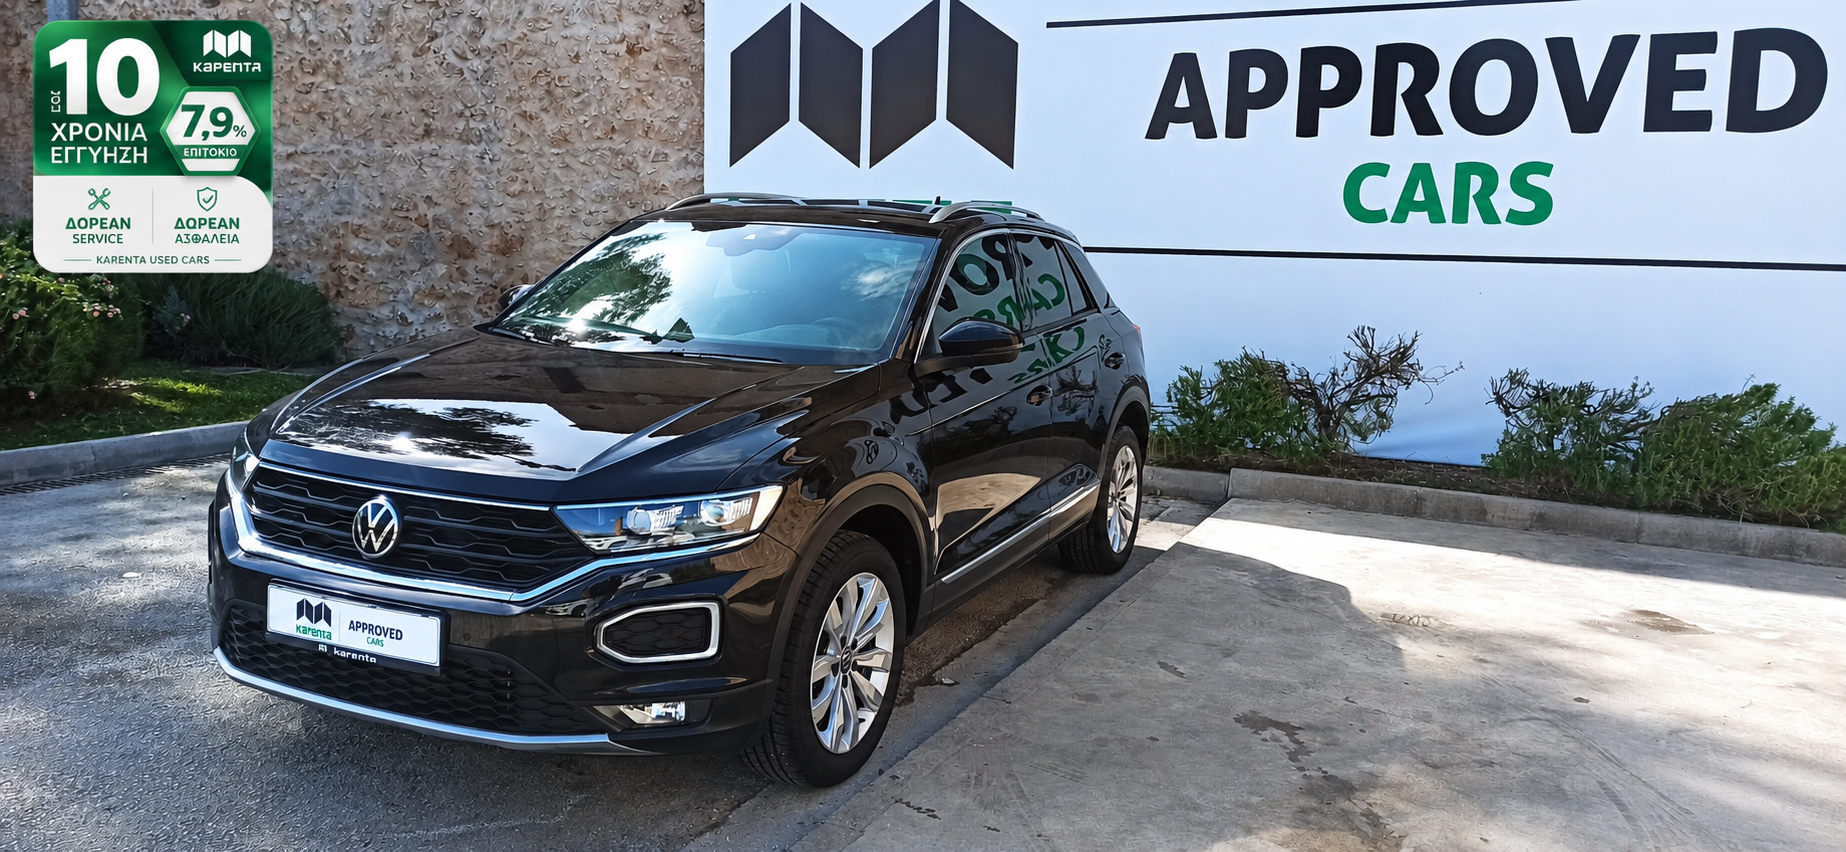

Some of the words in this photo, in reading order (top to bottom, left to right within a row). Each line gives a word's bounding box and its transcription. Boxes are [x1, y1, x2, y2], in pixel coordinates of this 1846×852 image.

[1145, 27, 1828, 139] APPROVED
[1343, 161, 1553, 225] CARS
[348, 620, 403, 641] APPROVED
